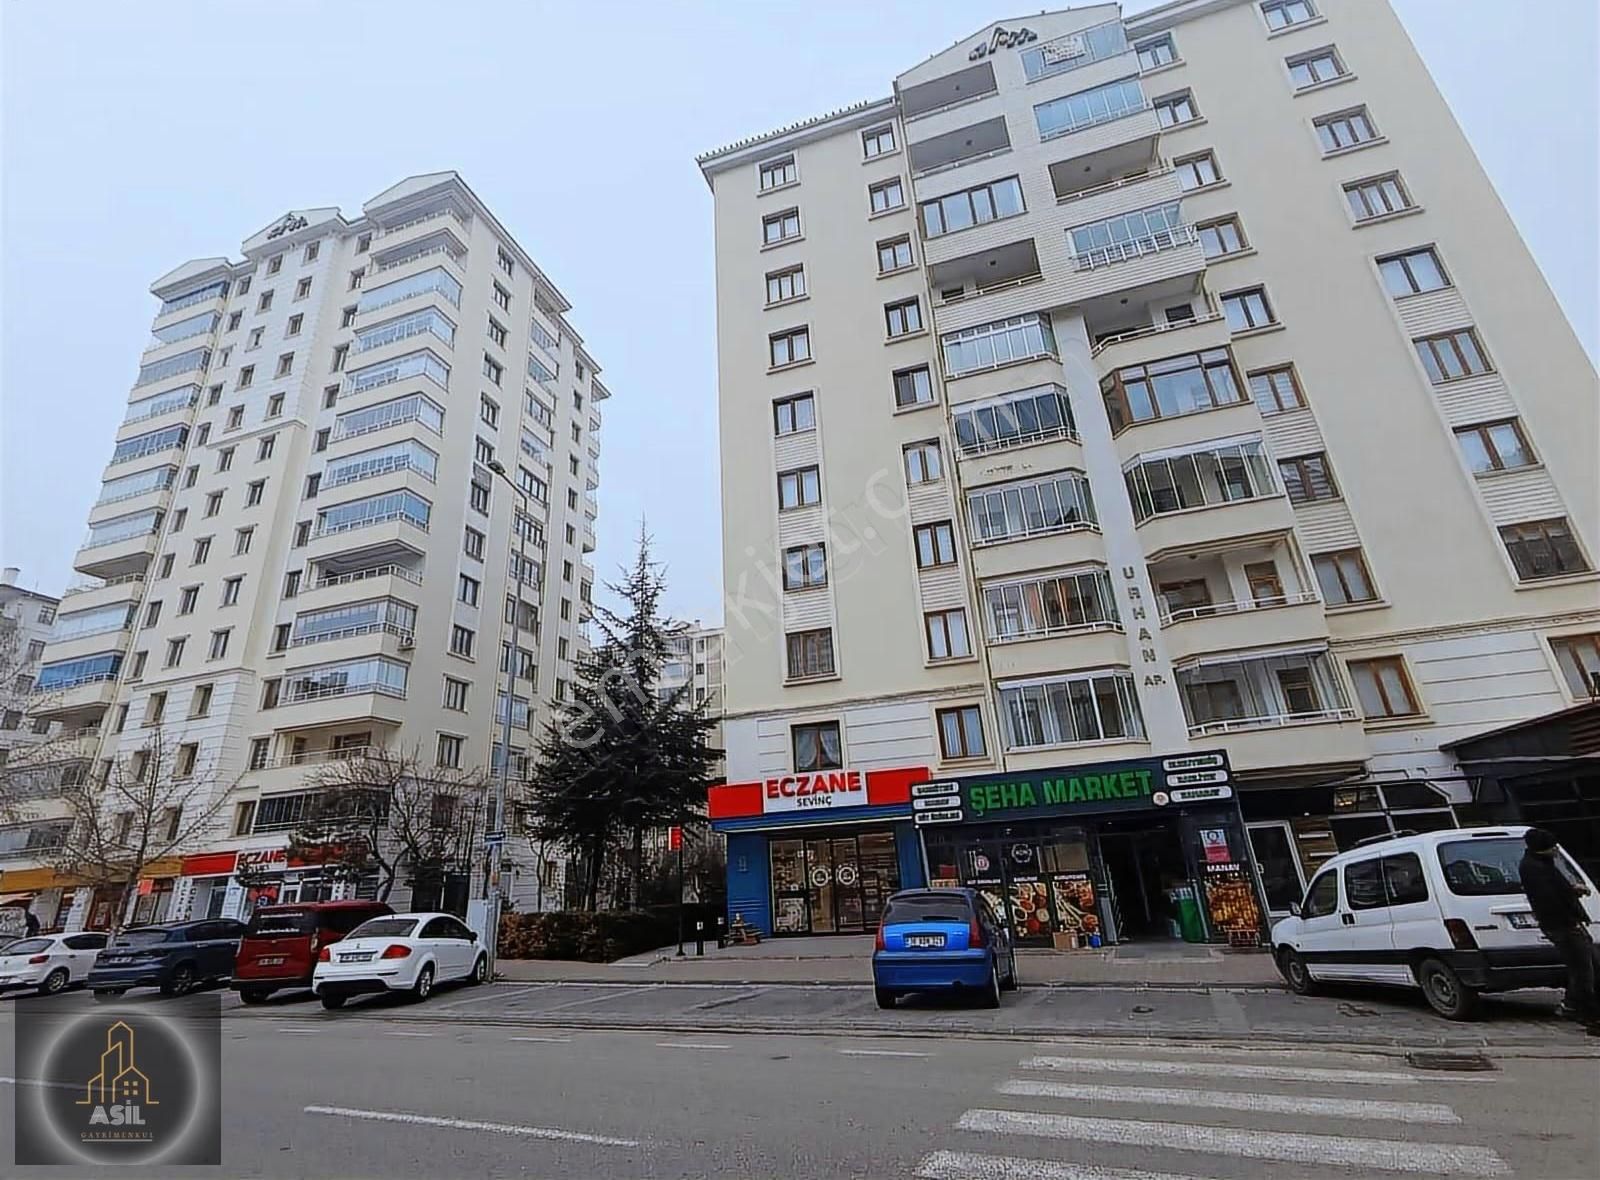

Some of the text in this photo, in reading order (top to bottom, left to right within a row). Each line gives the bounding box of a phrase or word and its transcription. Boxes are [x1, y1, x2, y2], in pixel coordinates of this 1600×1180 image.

[1144, 675, 1167, 686] AP.
[766, 771, 862, 799] ECZANE
[969, 770, 1153, 817] ŞEHA MARKET
[796, 794, 833, 808] SEVİNÇ
